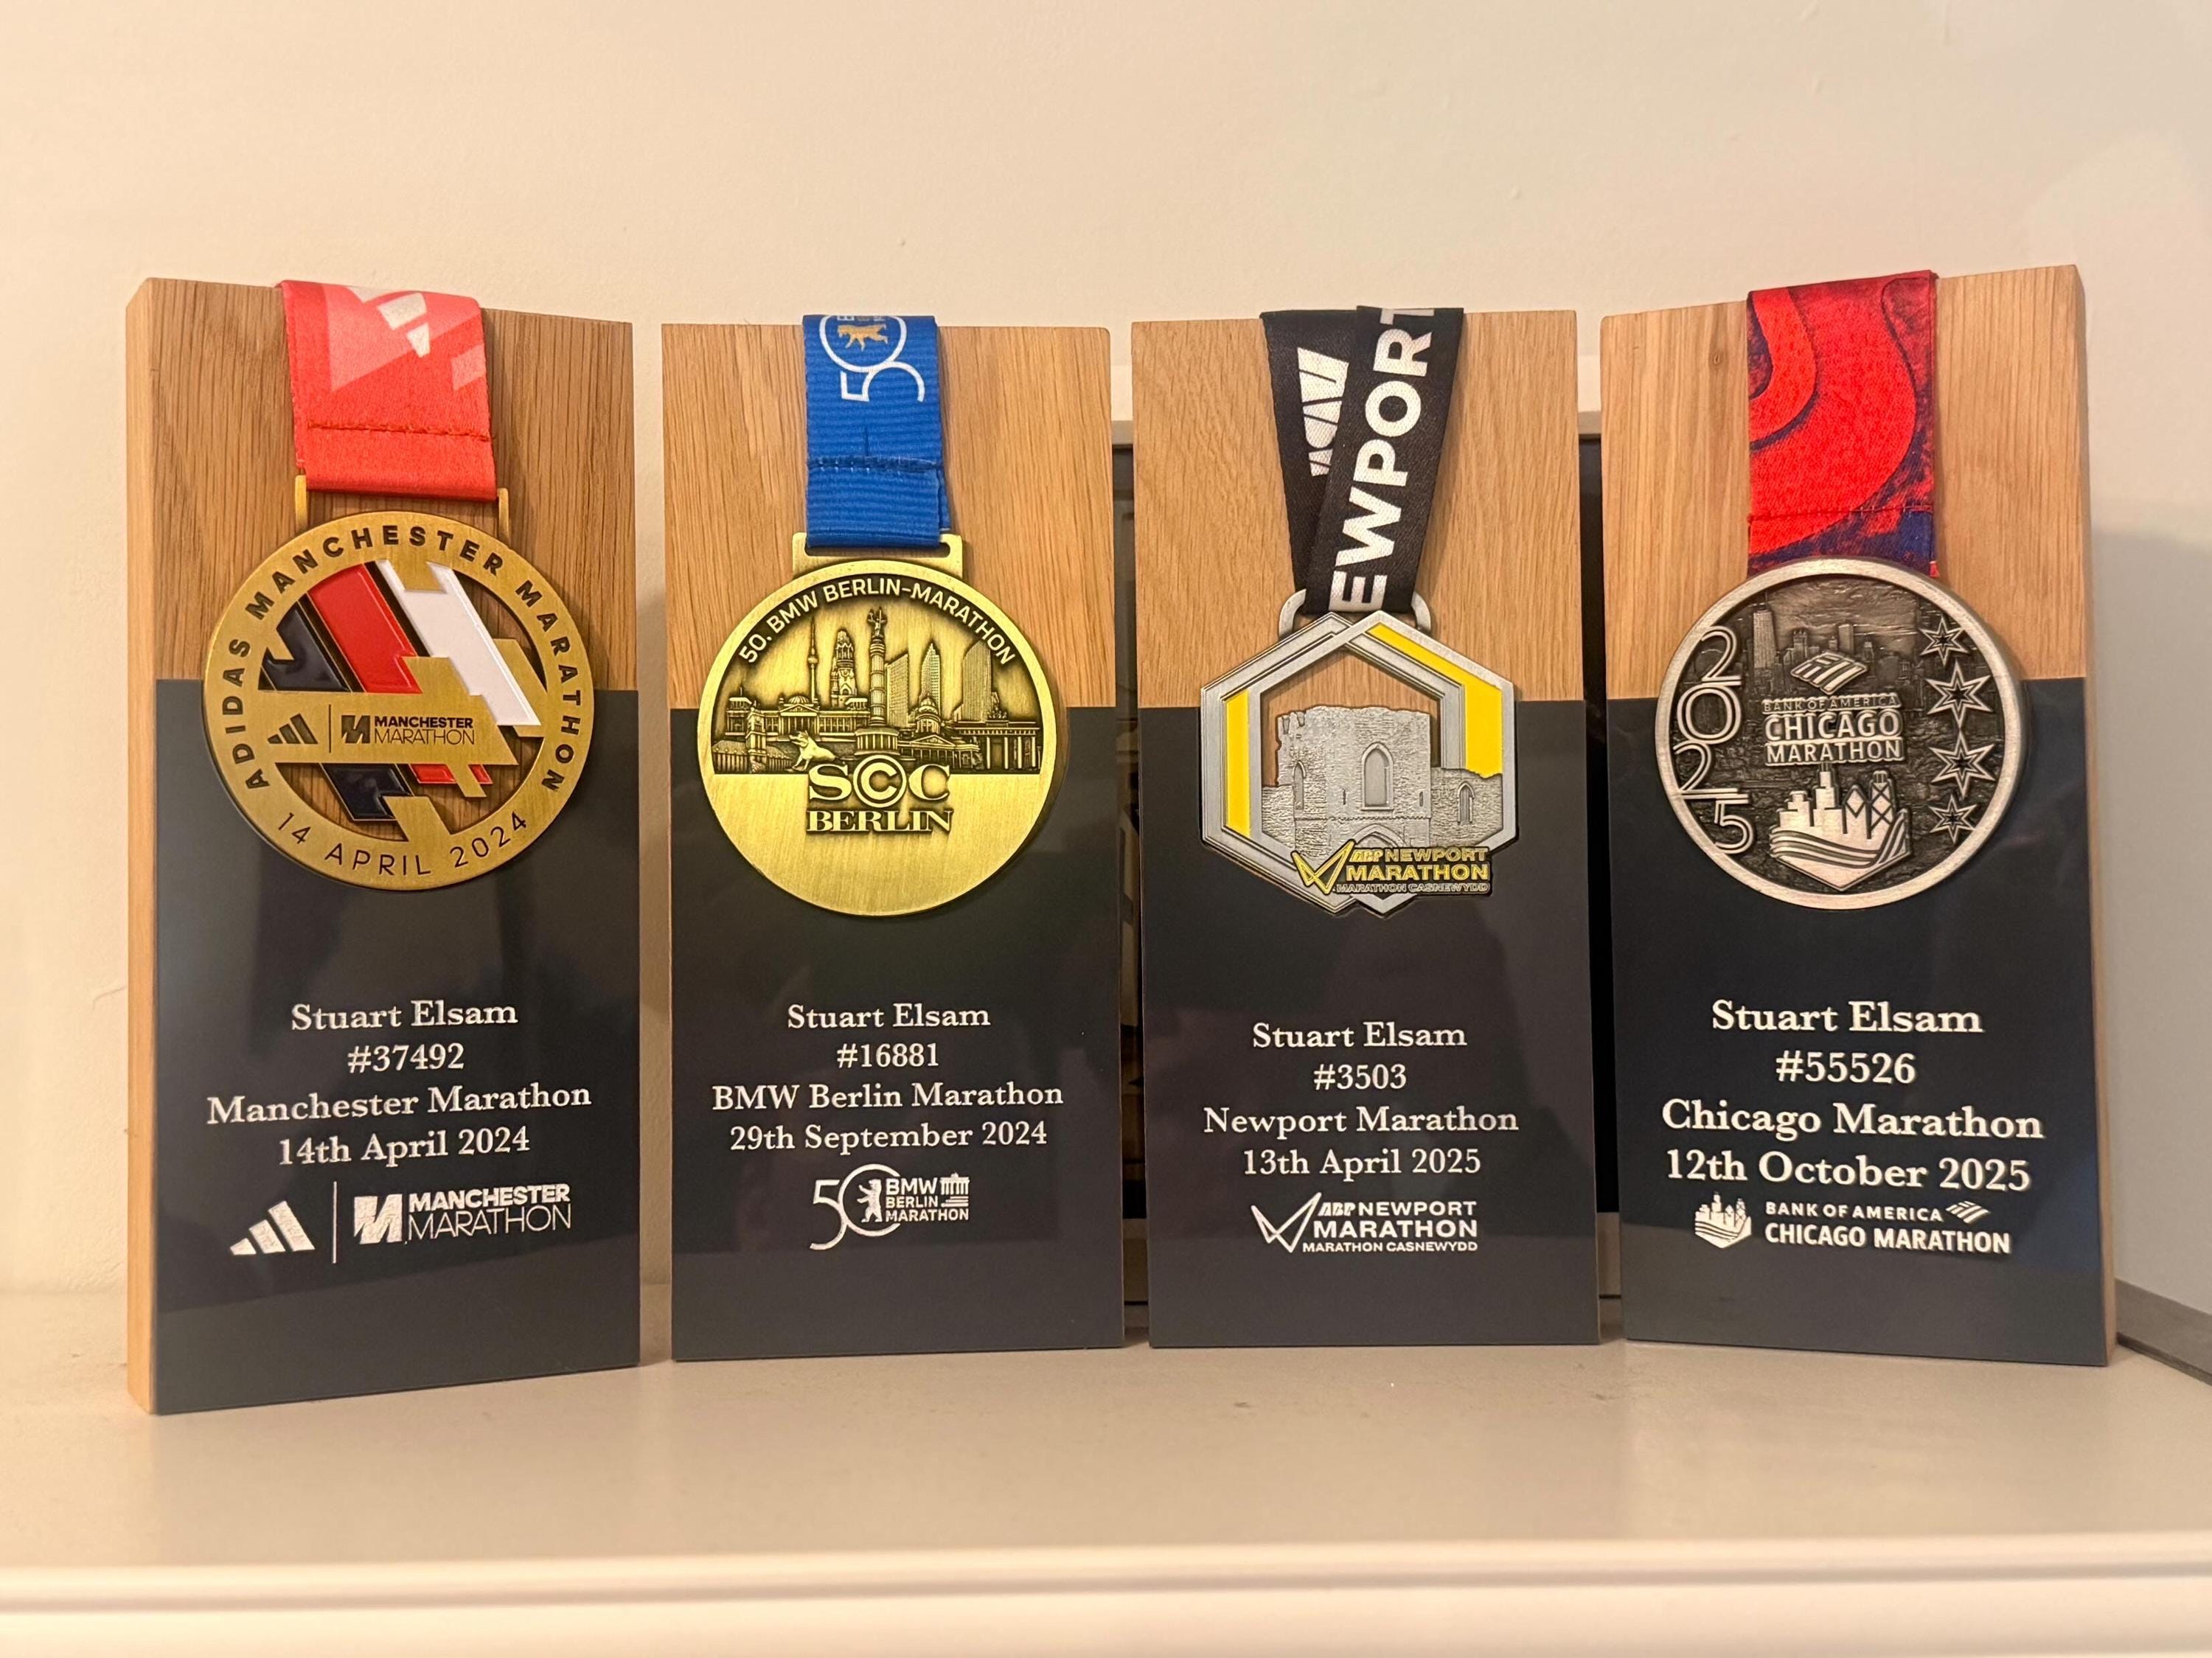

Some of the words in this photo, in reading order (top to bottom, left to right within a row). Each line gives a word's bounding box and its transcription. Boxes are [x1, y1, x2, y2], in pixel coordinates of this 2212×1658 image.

[739, 632, 772, 663] 50.
[766, 591, 819, 631] BMW
[824, 578, 1016, 664] BERLIN-MARATHON
[222, 639, 269, 790] ADIDAS
[246, 525, 503, 619] MANCHESTER
[516, 580, 581, 791] MARATHON
[1764, 701, 1802, 711] BANK
[1807, 700, 1826, 710] OF
[1830, 696, 1897, 708] AMERICA
[375, 716, 473, 728] MANCHESTER
[1765, 712, 1899, 740] CHICAGO
[375, 728, 474, 745] MARATHON
[1767, 740, 1899, 762] MARATHON
[808, 755, 951, 808] SCC
[807, 809, 953, 832] BERLIN
[277, 812, 309, 845] 14
[324, 843, 431, 876] APRIL
[450, 812, 526, 868] 2024
[1385, 848, 1488, 863] NEWPORT
[1346, 864, 1489, 881] MARATHON
[1336, 883, 1407, 894] MARATHON
[293, 1004, 401, 1030] Stuart
[411, 1000, 518, 1025] Elsam
[789, 1005, 883, 1028] Stuart
[893, 1003, 990, 1026] Elsam
[1713, 1000, 1837, 1031] Stuart
[1848, 1001, 1983, 1032] Elsam
[1253, 1023, 1354, 1048] Stuart
[1363, 1022, 1467, 1046] Elsam
[348, 1043, 464, 1073] #37492
[838, 1043, 938, 1067] #16881
[1776, 1051, 1915, 1083] #55526
[1314, 1064, 1406, 1090] #3503
[207, 1093, 418, 1124] Manchester
[428, 1082, 591, 1112] Marathon
[712, 1085, 799, 1110] BMW
[810, 1084, 902, 1107] Berlin
[912, 1081, 1063, 1106] Marathon
[1204, 1108, 1346, 1139] Newport
[1357, 1106, 1518, 1131] Marathon
[1663, 1098, 1820, 1141] Chicago
[1833, 1103, 2043, 1138] Marathon
[280, 1136, 351, 1164] 14th
[361, 1130, 448, 1167] April
[459, 1126, 529, 1154] 2024
[731, 1126, 795, 1150] 29th
[806, 1123, 973, 1155] September
[982, 1121, 1046, 1144] 2024
[1245, 1150, 1310, 1174] 13th
[1320, 1149, 1401, 1182] April
[1412, 1149, 1480, 1173] 2025
[1668, 1149, 1747, 1180] 12th
[1759, 1152, 1927, 1186] October
[1939, 1158, 2029, 1191] 2025
[409, 1184, 571, 1211] MANCHESTER
[886, 1178, 937, 1194] BMW
[810, 1163, 900, 1250] 50
[886, 1197, 938, 1209] BERLIN
[886, 1208, 968, 1222] MARATHON
[1359, 1202, 1476, 1216] NEWPORT
[1767, 1202, 1818, 1216] BANK
[1823, 1205, 1847, 1217] OF
[1853, 1206, 1942, 1221] AMERICA
[409, 1203, 571, 1241] MARATHON
[1314, 1220, 1476, 1238] MARATHON
[1303, 1242, 1382, 1252] MARATHON
[1386, 1241, 1478, 1251] CASNEWYDD
[1765, 1223, 1865, 1247] CHICAGO
[1874, 1228, 2009, 1253] MARATHON
